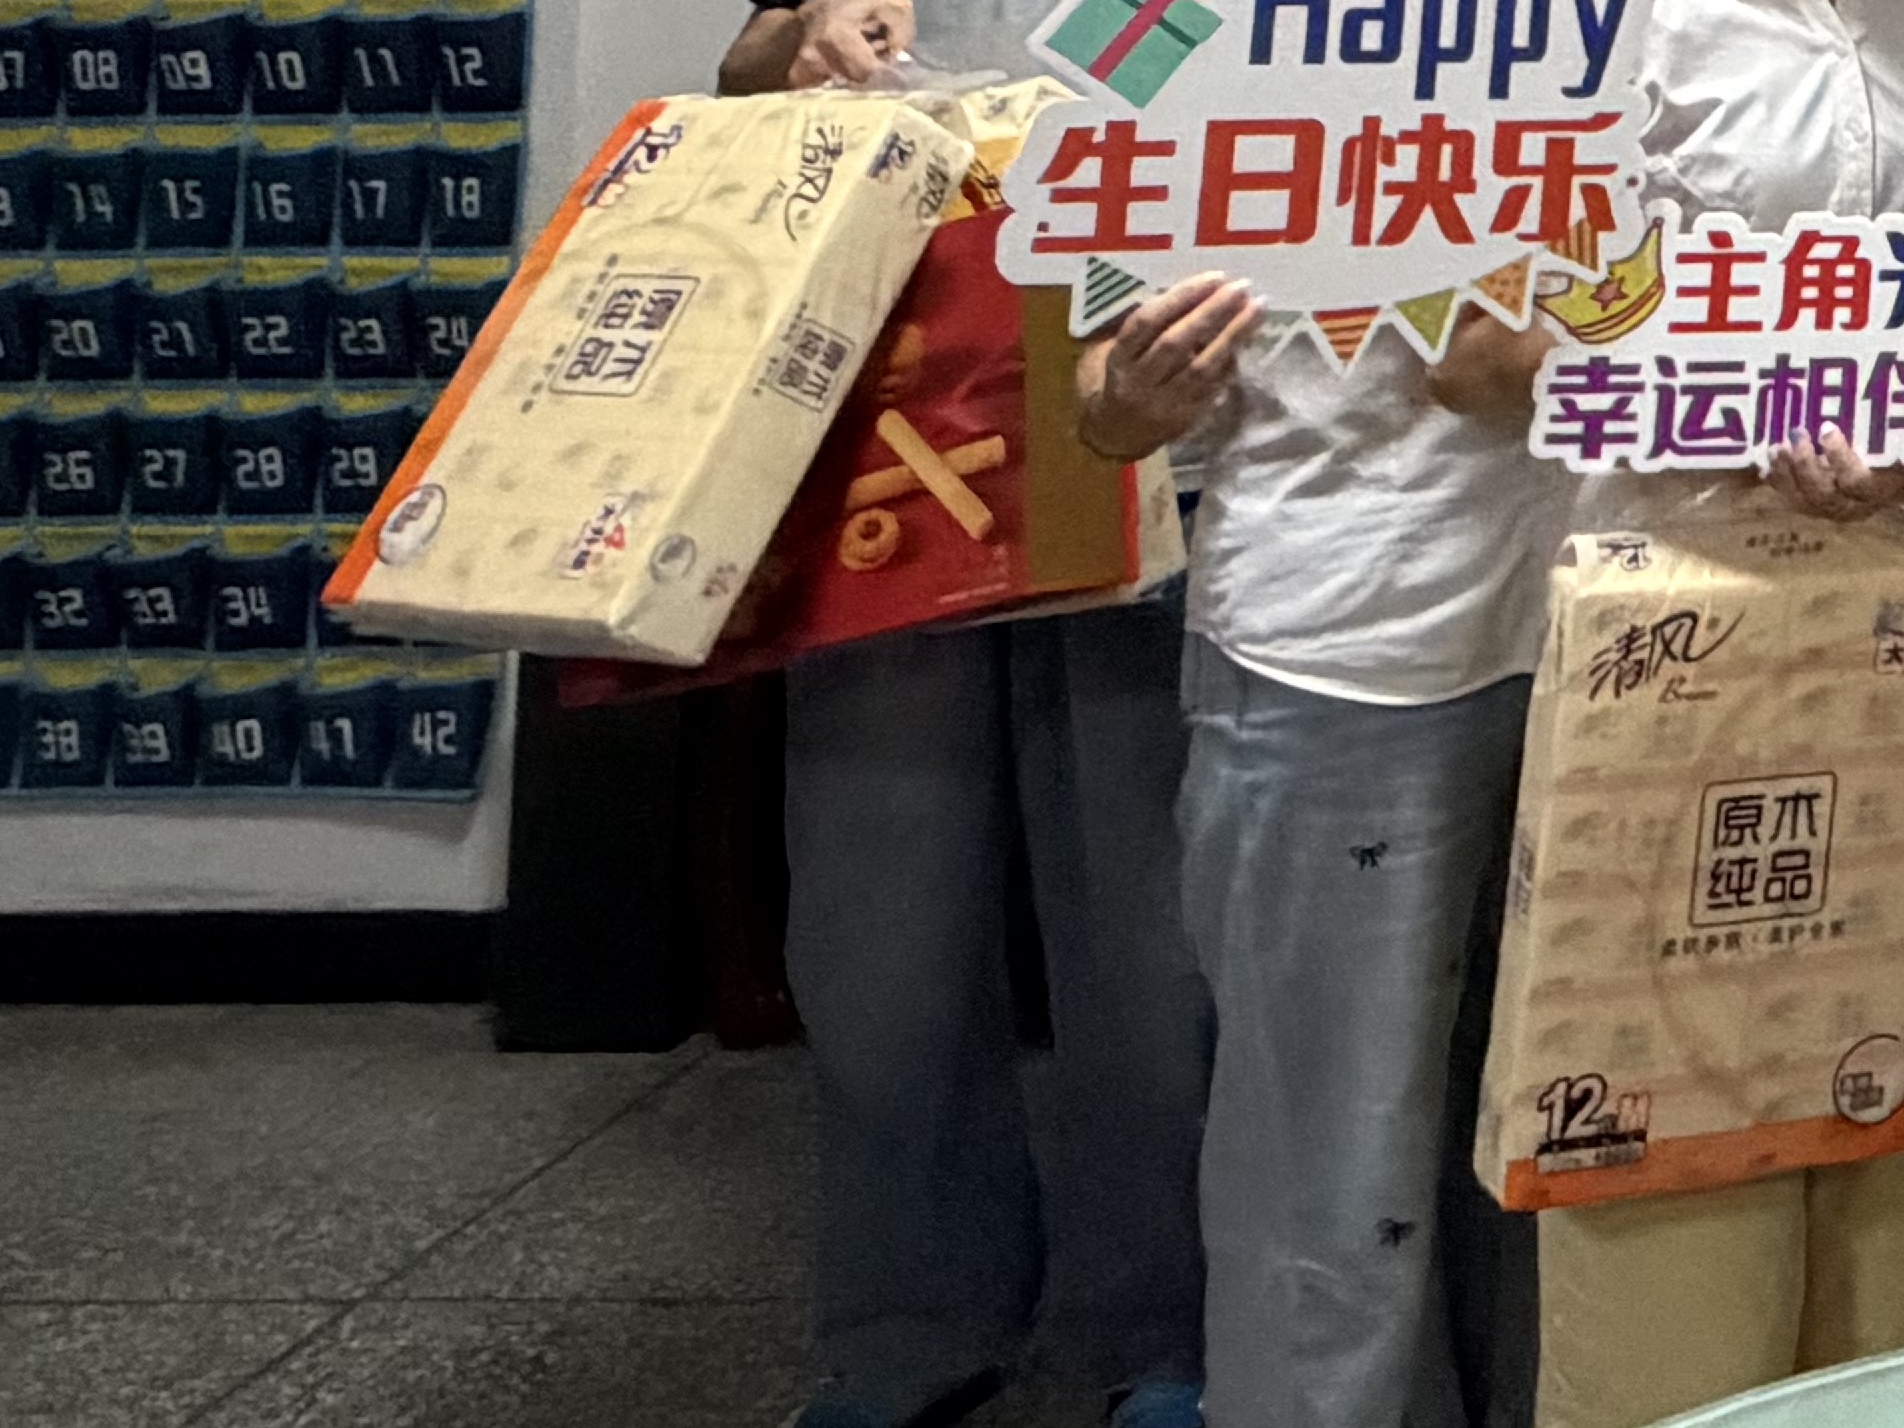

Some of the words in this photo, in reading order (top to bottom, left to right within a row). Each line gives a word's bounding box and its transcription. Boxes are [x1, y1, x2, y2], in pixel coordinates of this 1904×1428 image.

[72, 50, 120, 90] 08
[160, 50, 212, 90] 09
[255, 50, 306, 90] 10
[353, 47, 401, 87] 11
[441, 46, 489, 87] 12
[66, 182, 115, 224] 14
[160, 179, 203, 221] 15
[251, 182, 294, 222] 16
[347, 180, 389, 220] 17
[440, 177, 482, 219] 18
[1030, 112, 1626, 254] 生日快乐
[50, 319, 99, 357] 20
[148, 319, 198, 358] 21
[241, 315, 294, 355] 22
[339, 318, 387, 355] 23
[425, 316, 471, 355] 24
[43, 449, 96, 491] 26
[140, 448, 188, 488] 27
[233, 447, 286, 489] 28
[331, 446, 378, 486] 29
[34, 587, 90, 628] 32
[123, 586, 177, 626] 33
[219, 585, 274, 626] 34
[1588, 610, 1745, 701] 清风
[36, 719, 81, 762] 38
[210, 717, 265, 761] 40
[411, 710, 459, 756] 42
[1711, 789, 1822, 848] 原木
[1706, 848, 1813, 910] 纯品
[1537, 1073, 1608, 1141] 12
